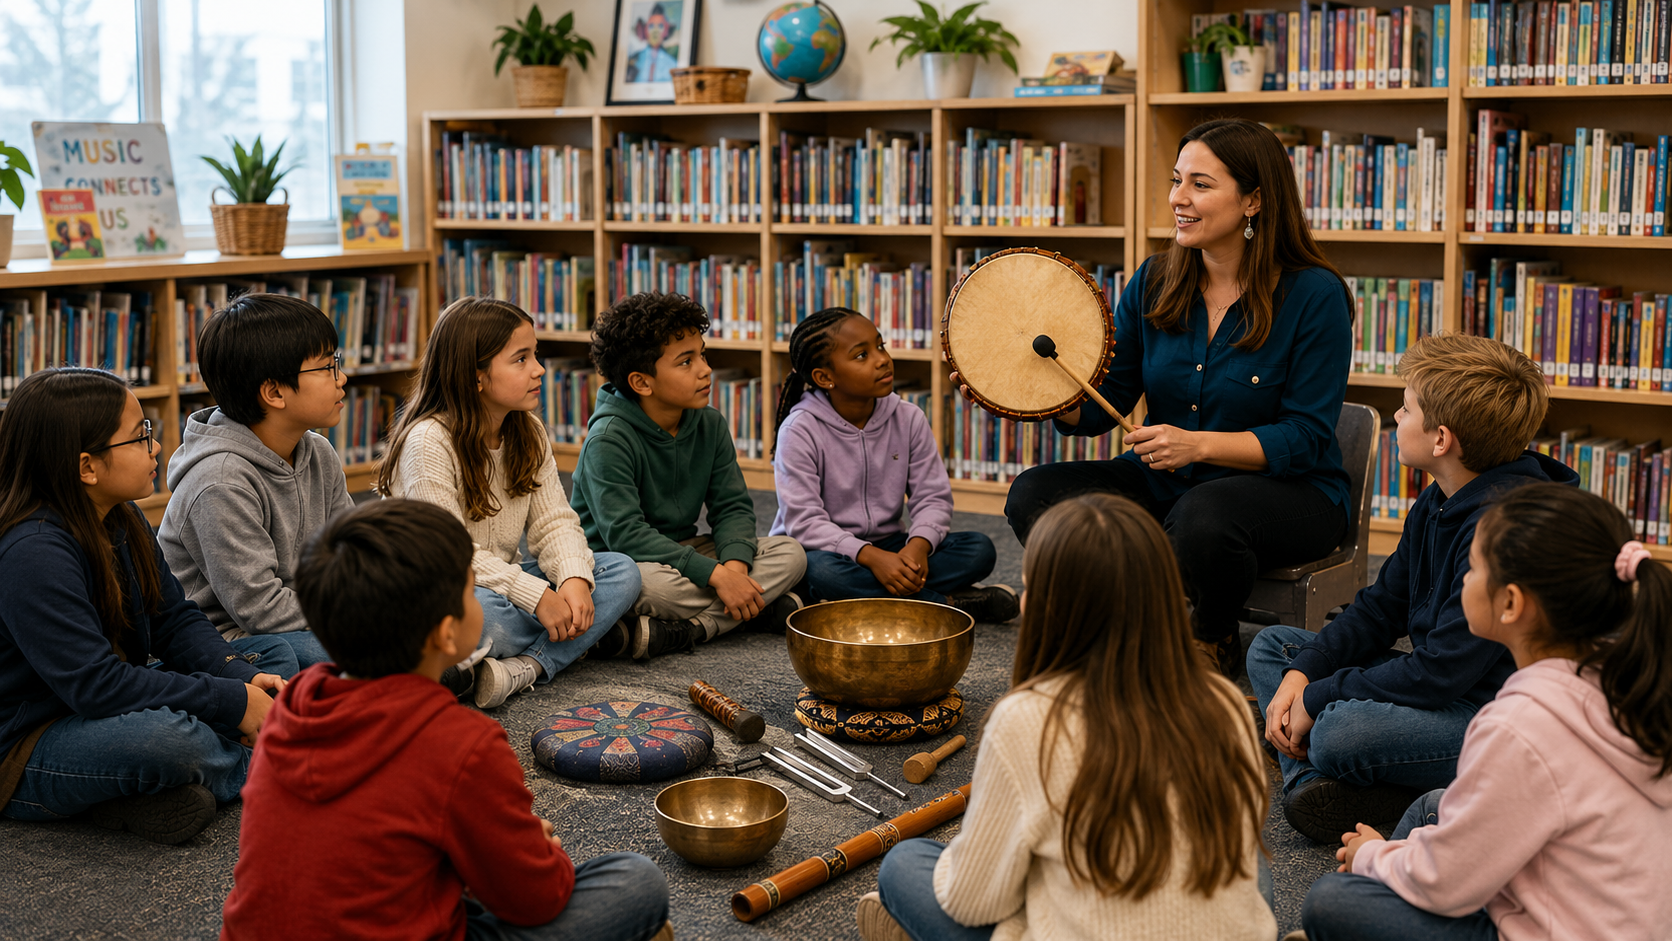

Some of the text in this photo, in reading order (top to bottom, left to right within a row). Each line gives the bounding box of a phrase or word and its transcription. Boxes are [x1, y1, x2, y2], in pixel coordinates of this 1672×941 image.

[63, 139, 143, 164] MUSIC
[65, 177, 162, 196] CONNECTS
[100, 207, 129, 230] US
